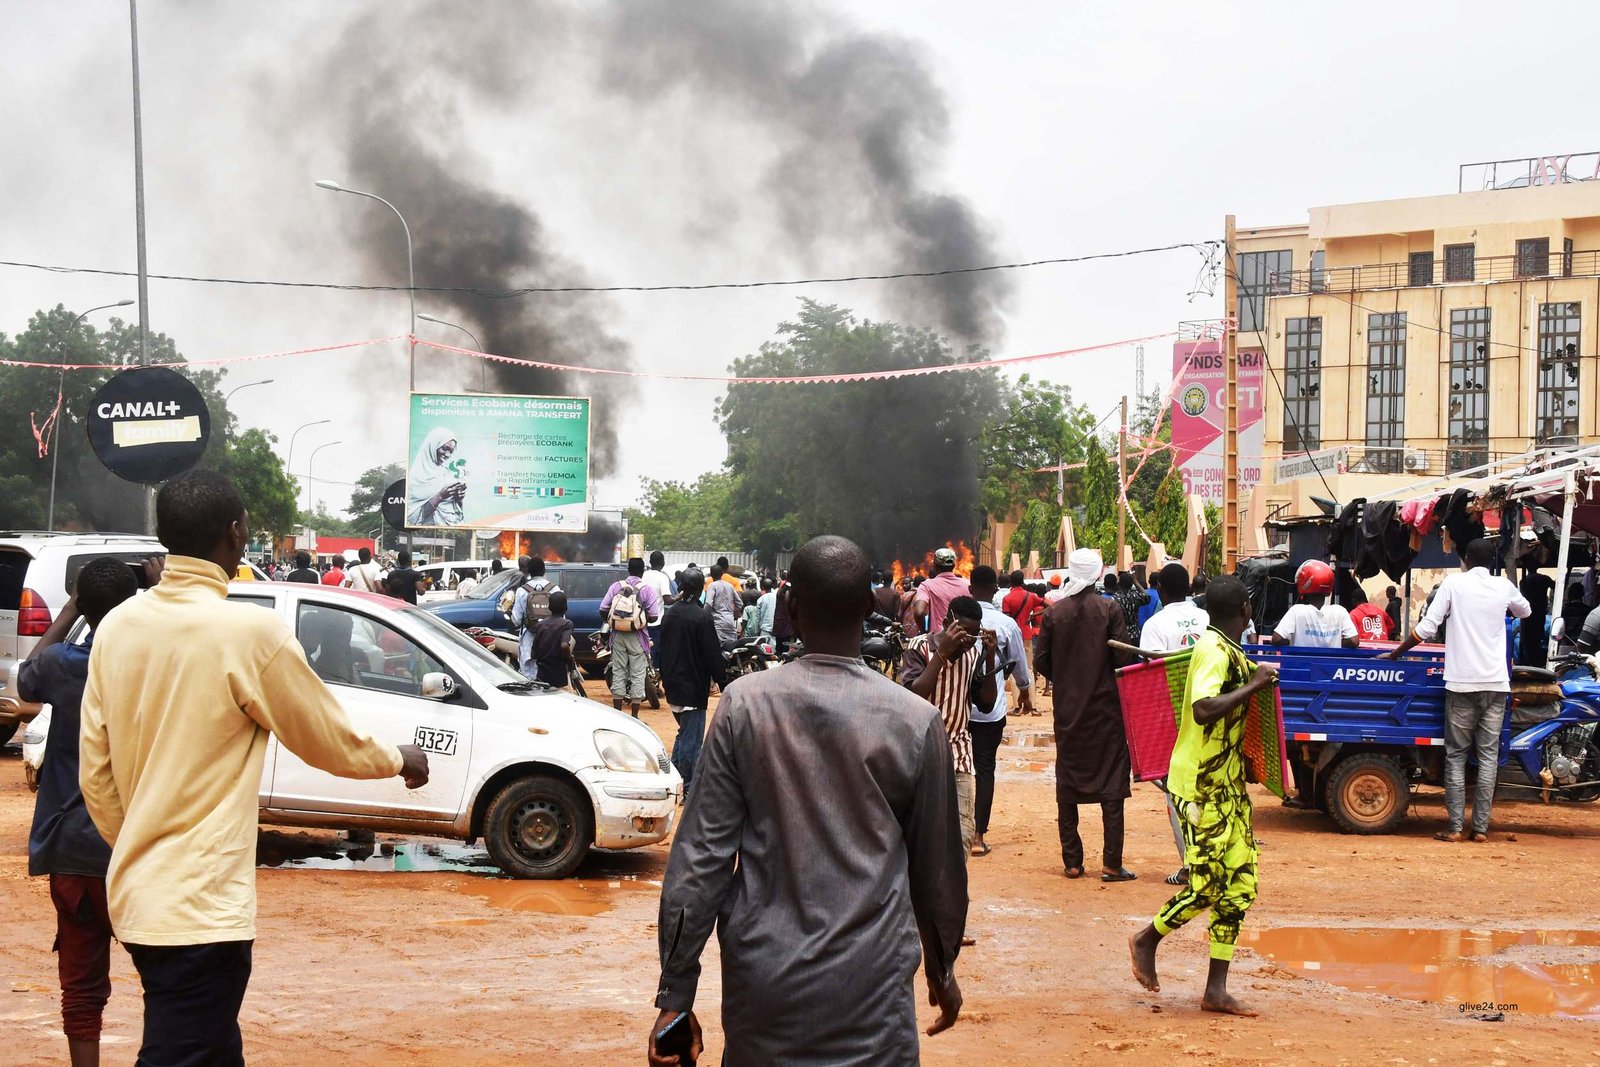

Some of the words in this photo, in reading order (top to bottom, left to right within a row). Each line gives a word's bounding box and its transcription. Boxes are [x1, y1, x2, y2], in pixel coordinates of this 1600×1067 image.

[1184, 355, 1223, 369] PNDS
[97, 401, 181, 419] CANAL+
[421, 397, 469, 407] Services
[472, 398, 521, 408] Ecobank
[524, 399, 583, 410] désormais
[421, 407, 476, 416] disponibles
[487, 409, 523, 417] AMANA
[525, 410, 583, 419] TRANSFERT
[124, 422, 190, 441] family
[387, 497, 406, 505] CAN
[1332, 668, 1405, 682] APSONIC
[417, 730, 454, 751] 9327
